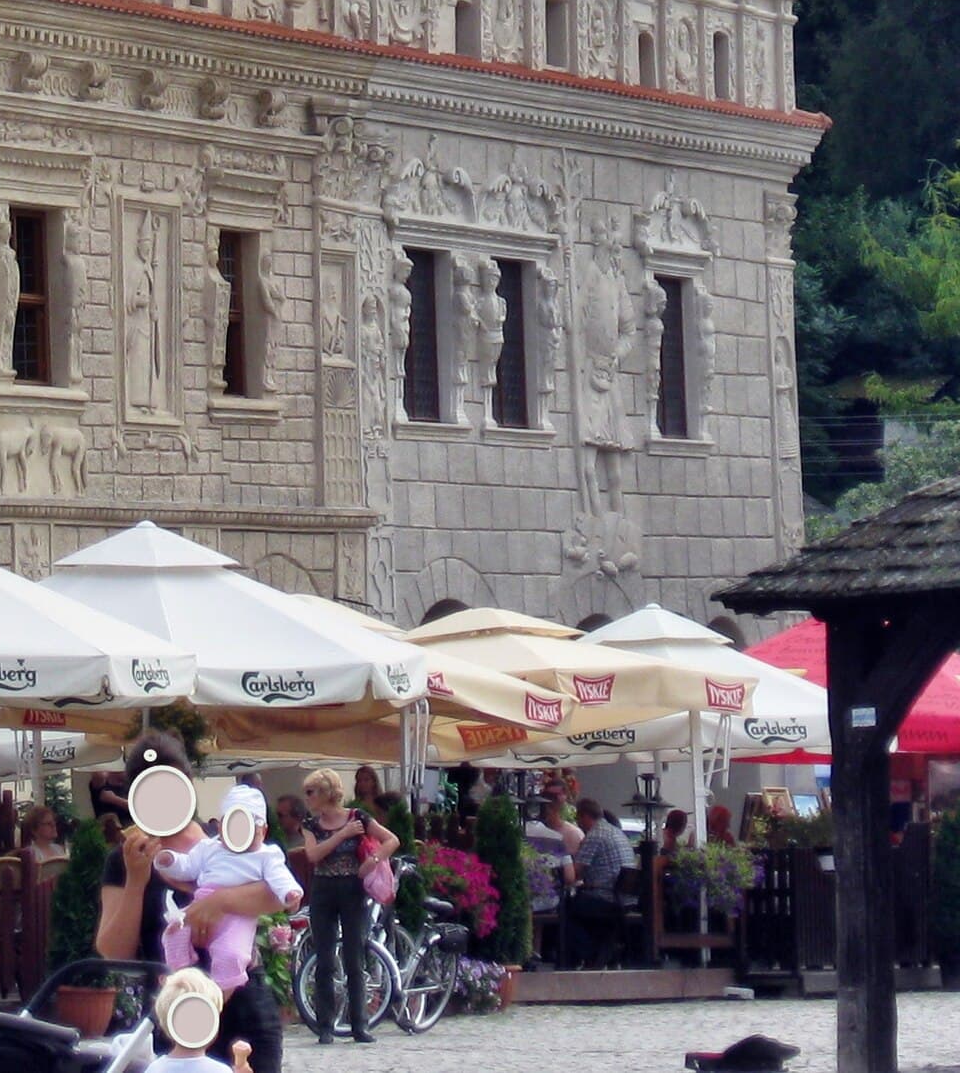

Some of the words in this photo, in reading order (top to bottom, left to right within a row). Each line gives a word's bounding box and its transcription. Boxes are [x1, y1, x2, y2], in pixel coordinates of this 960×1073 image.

[132, 659, 171, 687] Carlsberg
[241, 671, 315, 697] Carlsberg
[575, 679, 610, 699] TYSKIE
[707, 682, 743, 707] TYSKIE
[744, 717, 807, 740] Carlsberg
